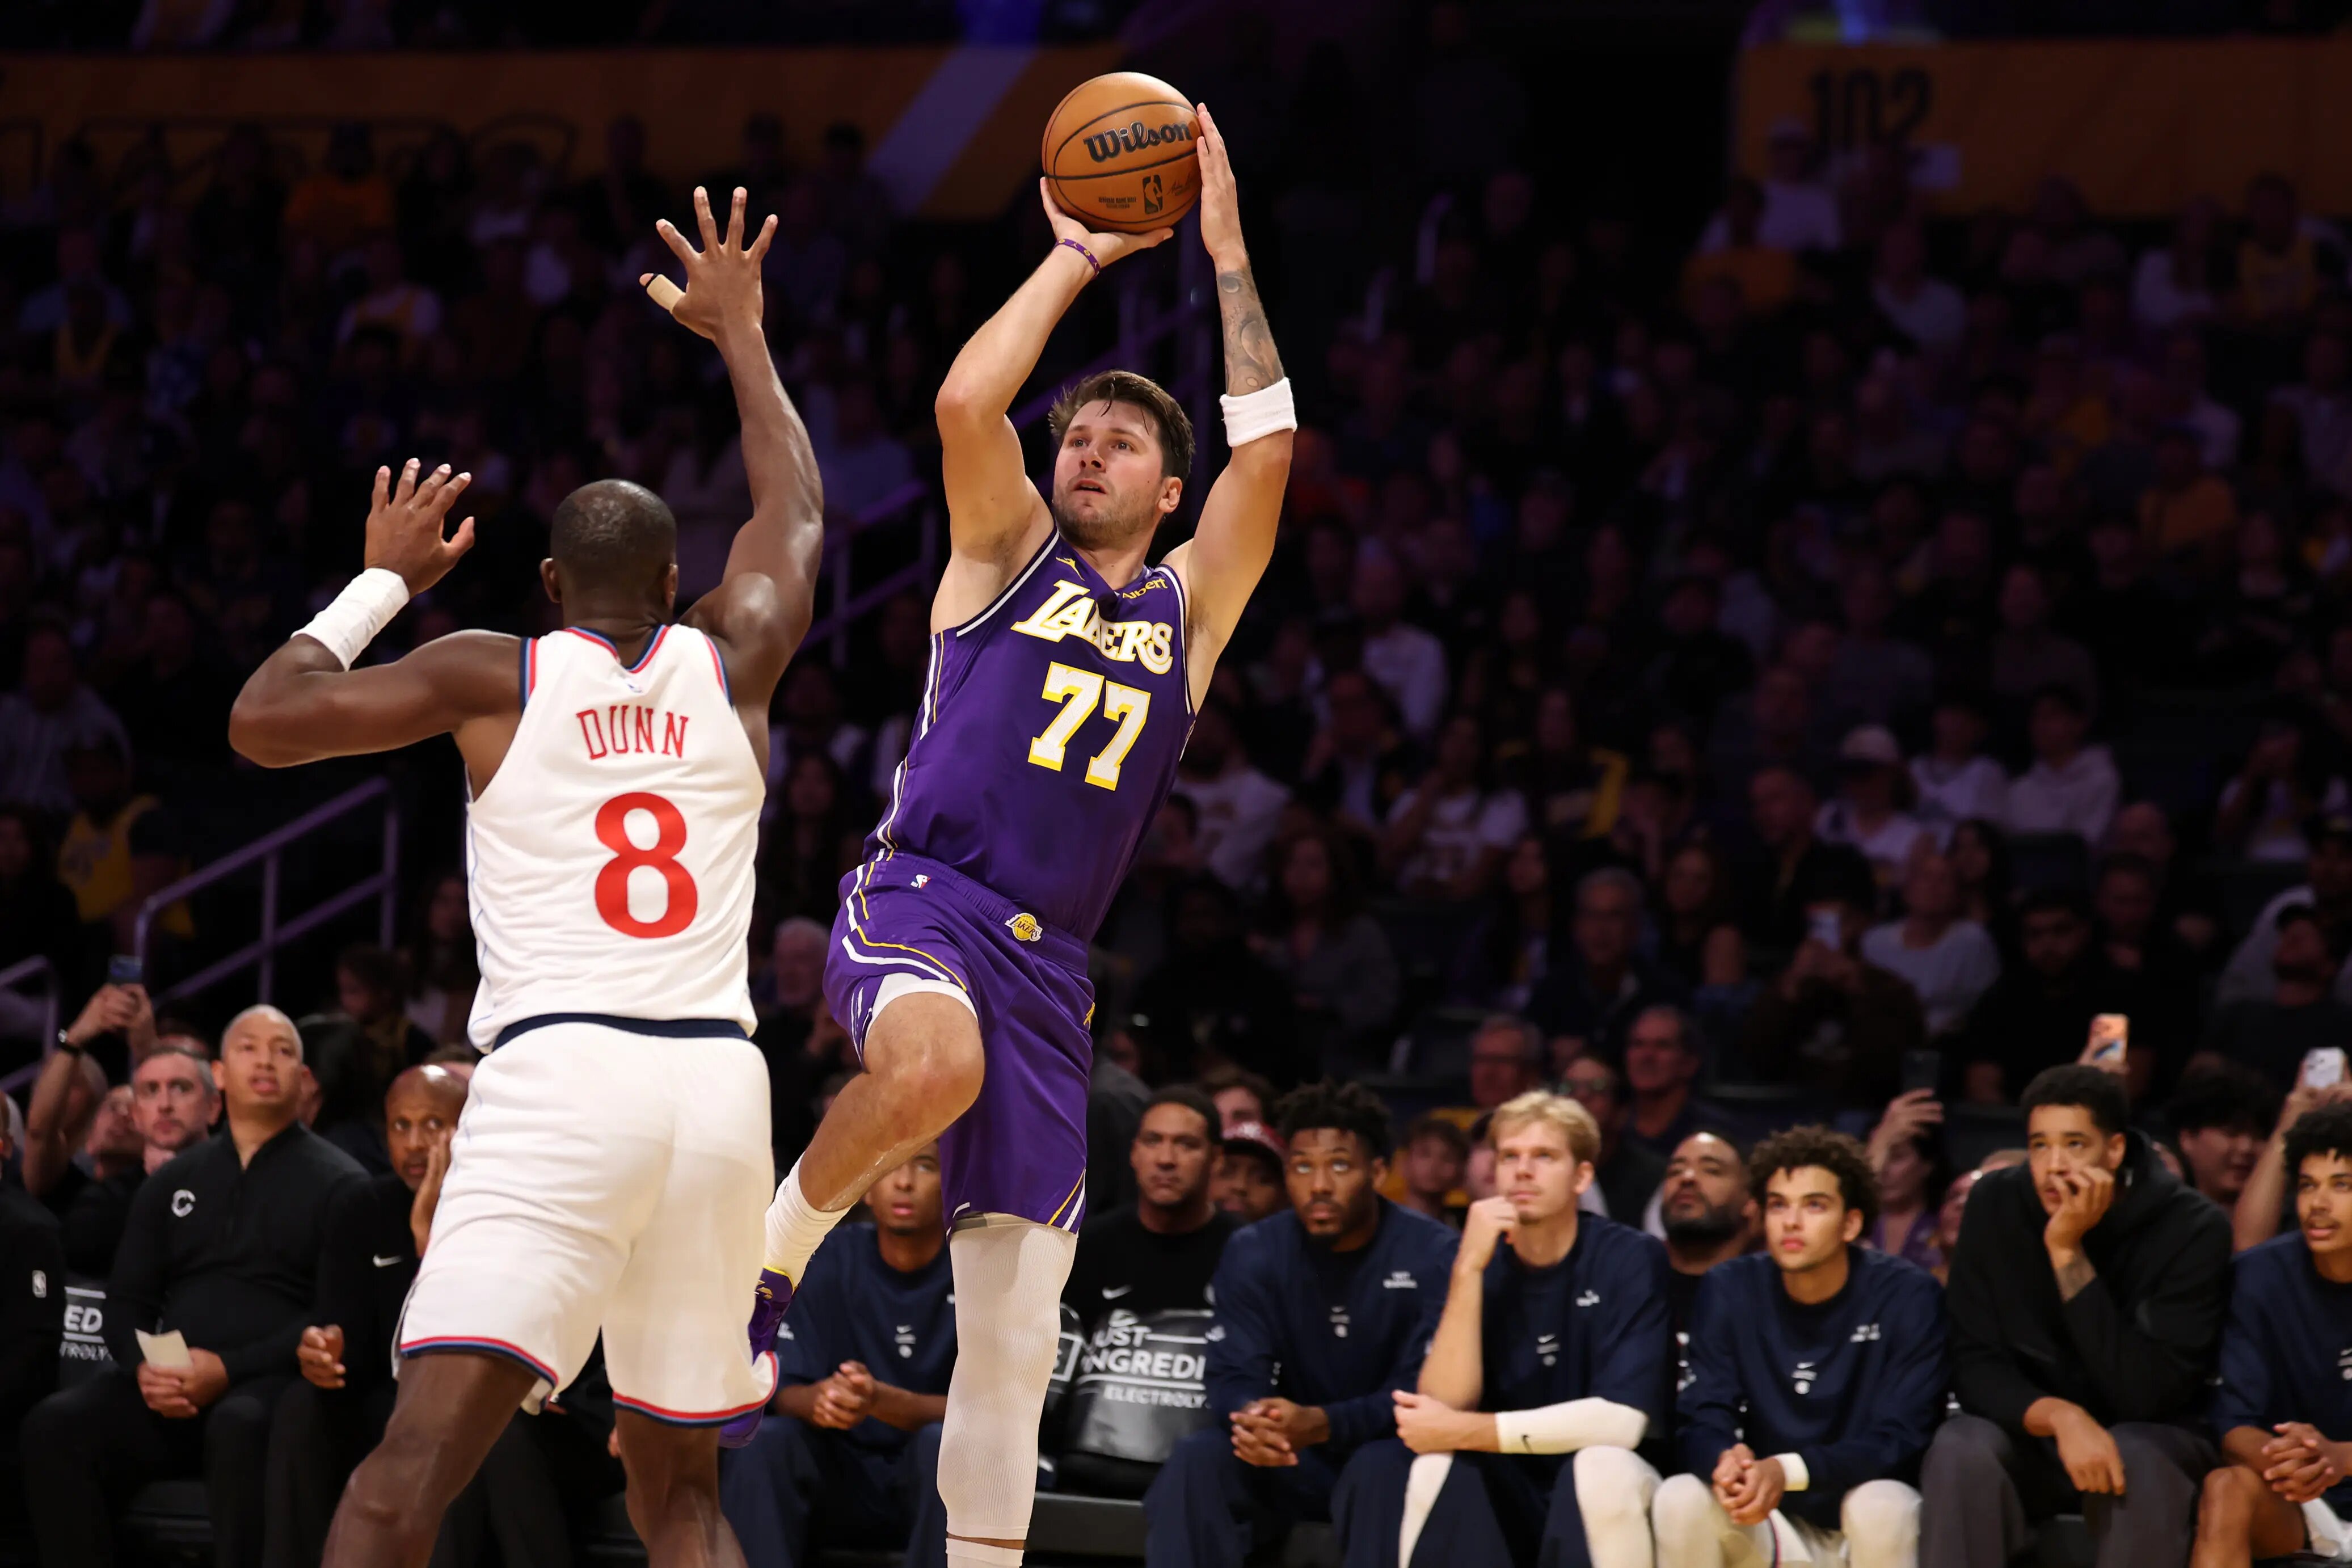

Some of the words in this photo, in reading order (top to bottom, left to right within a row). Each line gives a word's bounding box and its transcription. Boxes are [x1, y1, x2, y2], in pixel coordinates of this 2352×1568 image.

[1083, 121, 1193, 163] Wilson
[1811, 67, 1931, 156] 102
[576, 705, 689, 760] DUNN
[1027, 661, 1152, 792] 77
[595, 792, 698, 939] 8
[1005, 914, 1042, 942] LAKERS
